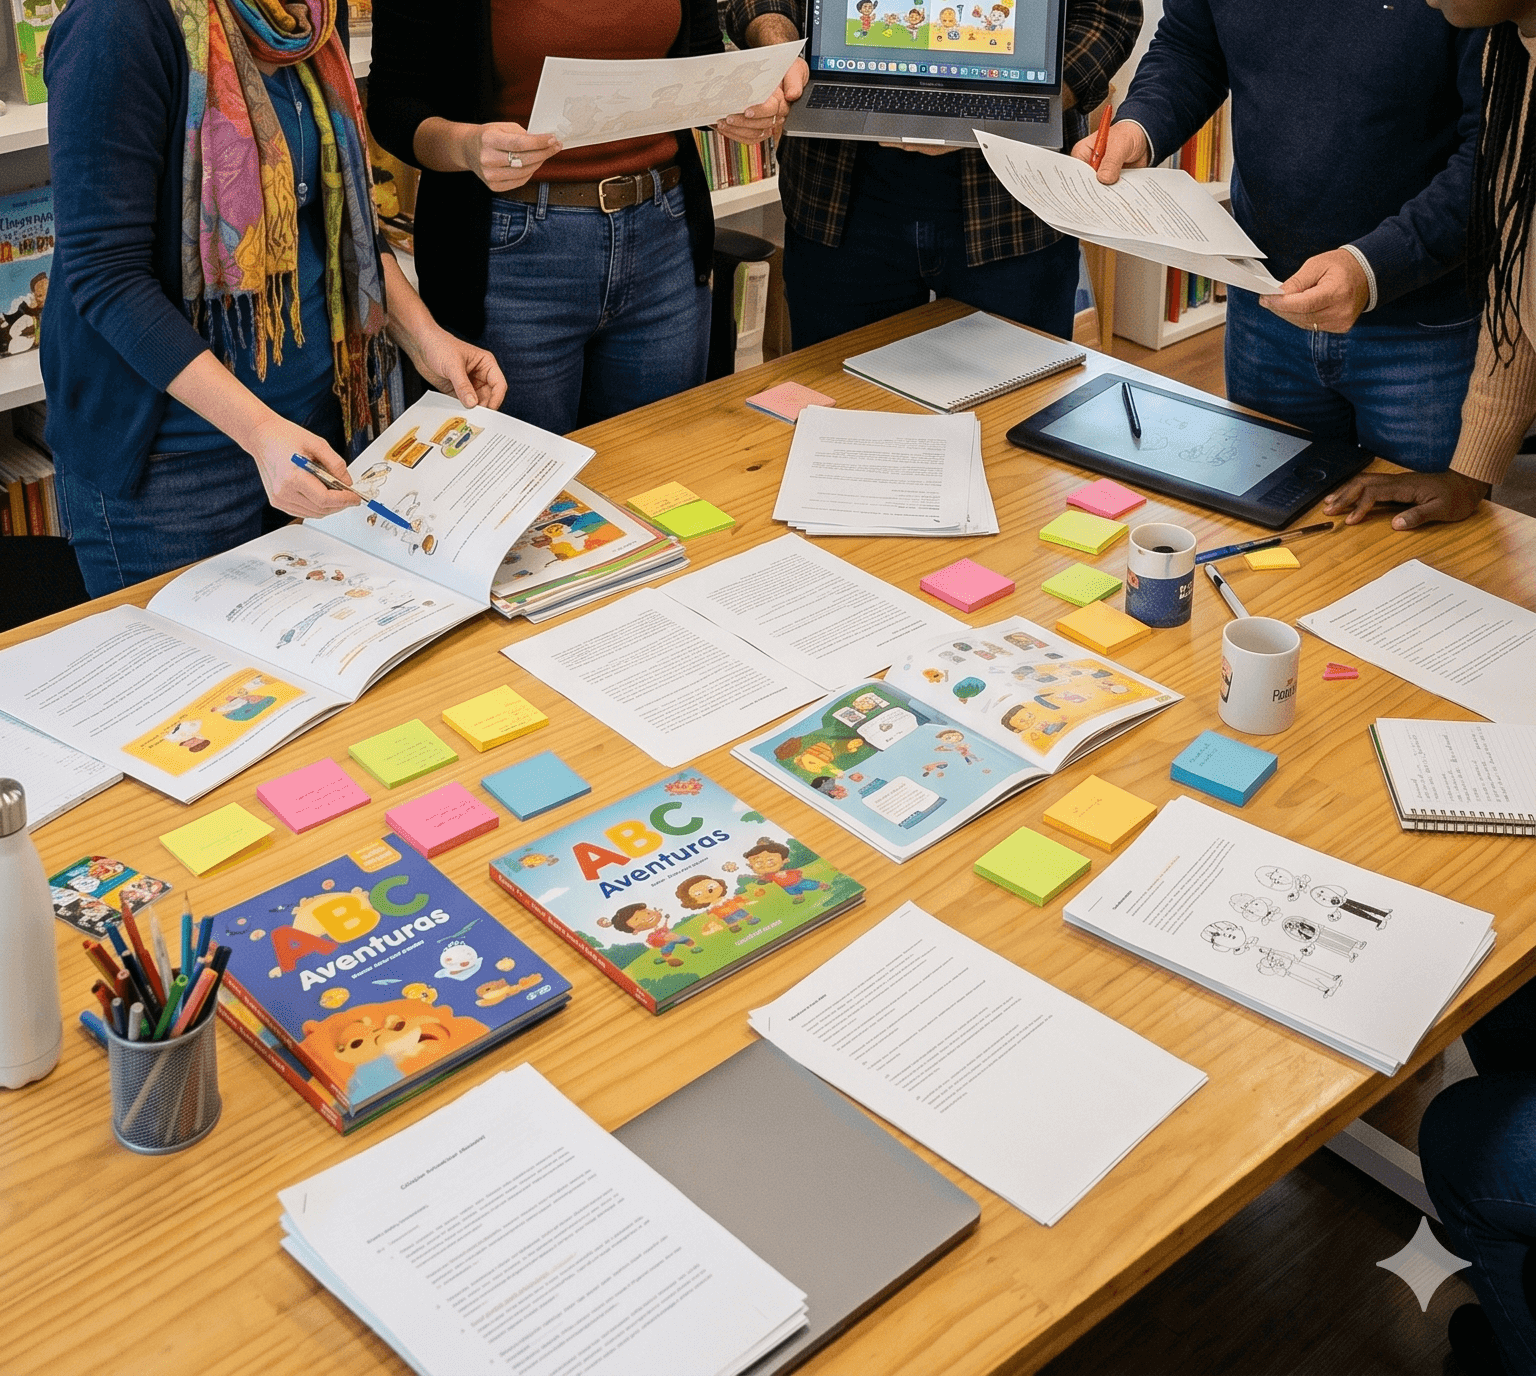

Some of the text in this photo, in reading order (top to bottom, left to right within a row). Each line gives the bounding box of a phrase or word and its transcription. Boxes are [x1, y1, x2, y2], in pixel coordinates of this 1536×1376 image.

[571, 801, 704, 881] ABC
[598, 828, 731, 899] Aventuras
[270, 874, 430, 973] ABC
[298, 908, 451, 991] Aventuras
